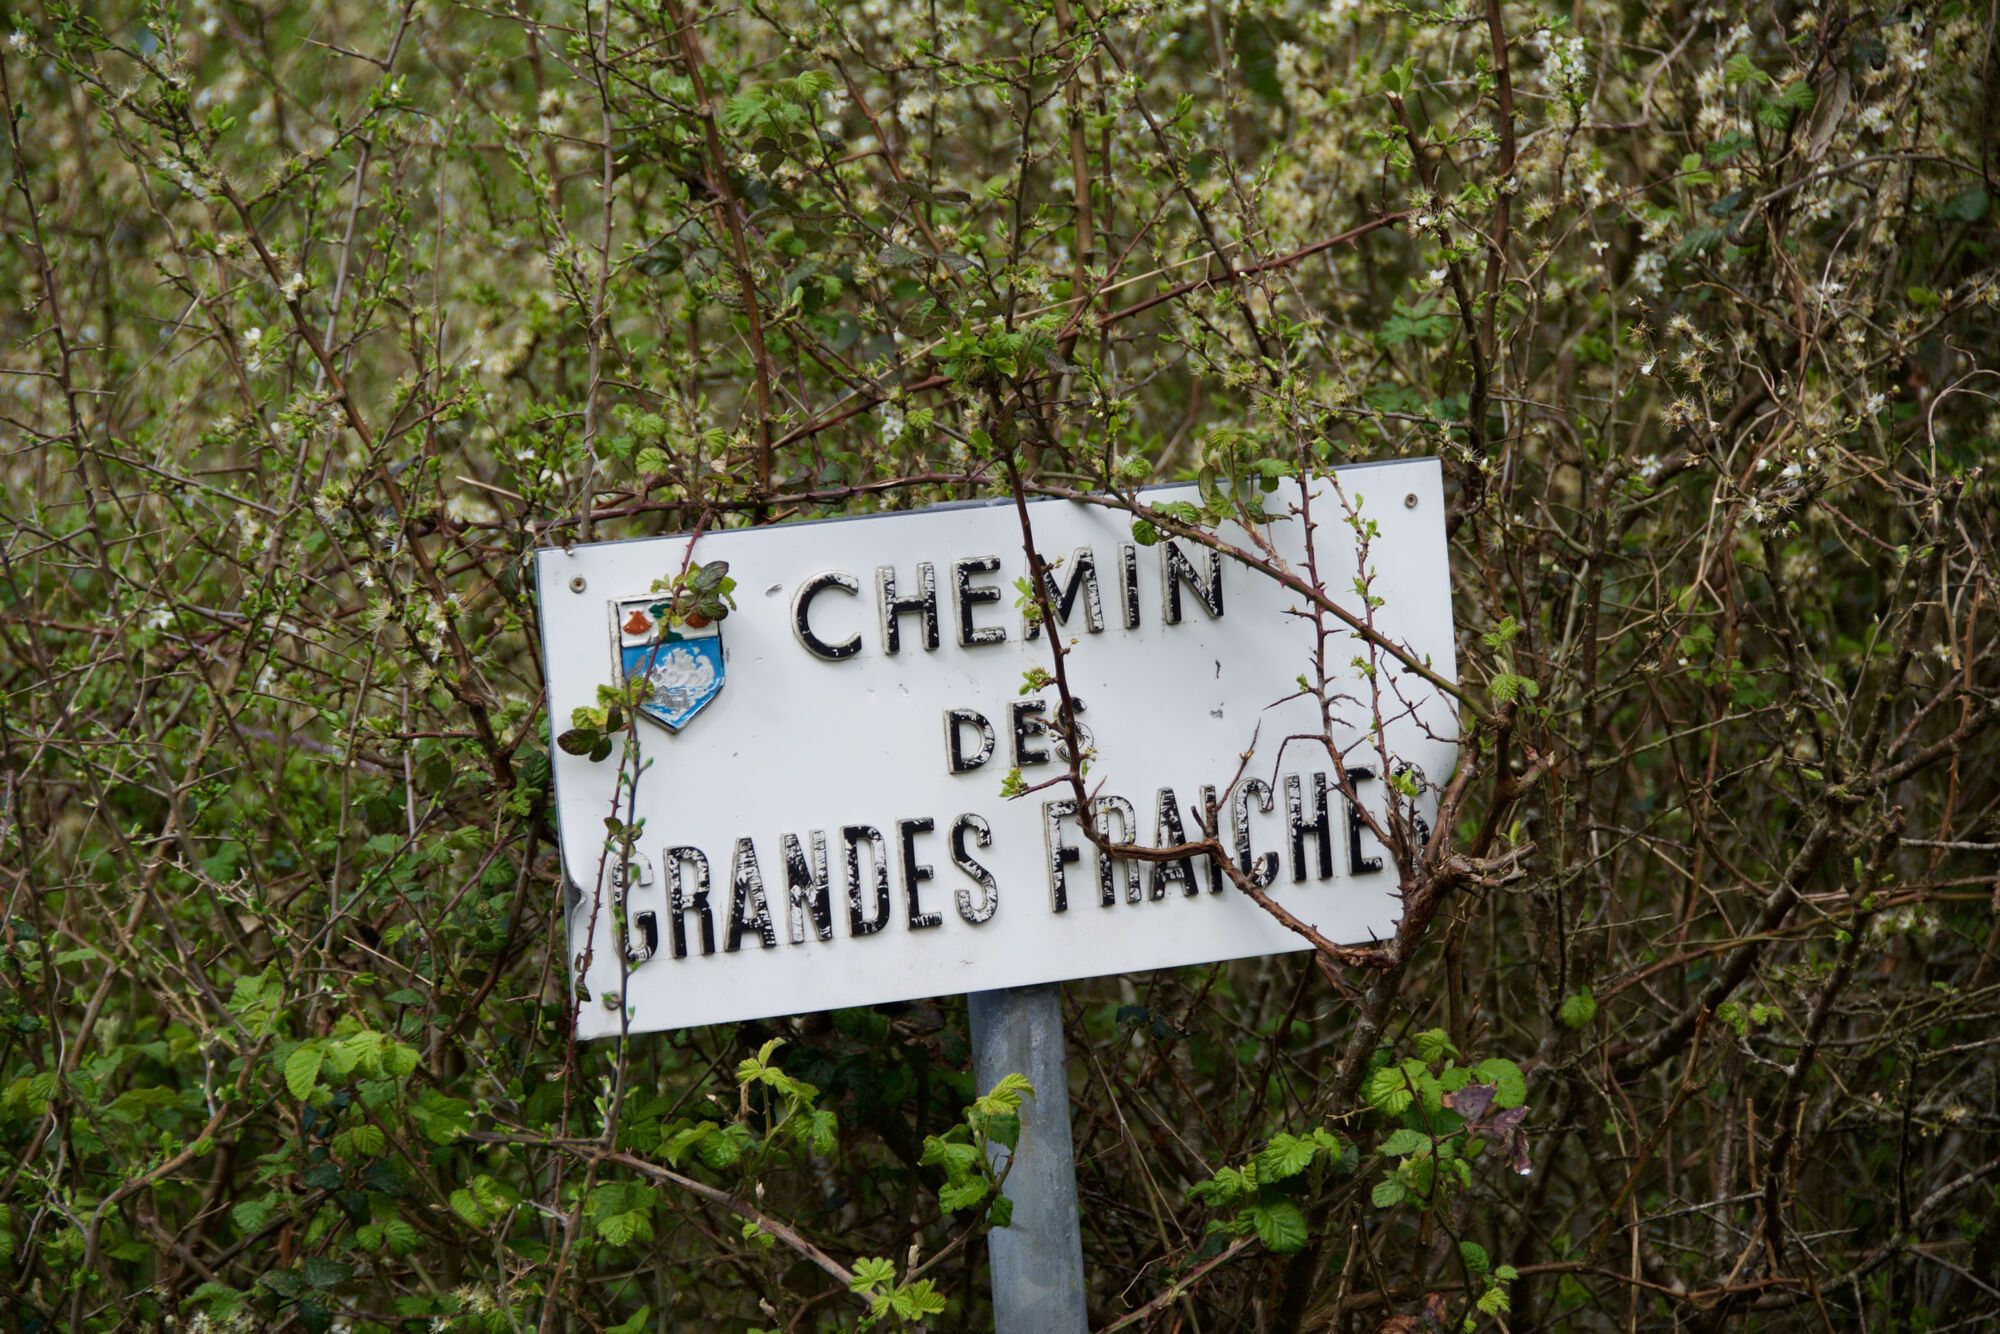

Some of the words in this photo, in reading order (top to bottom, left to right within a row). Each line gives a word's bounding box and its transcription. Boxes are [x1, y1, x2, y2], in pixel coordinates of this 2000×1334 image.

[790, 540, 1224, 661] CHEMIN
[943, 696, 1095, 774] DES
[607, 812, 999, 962] GRANDES
